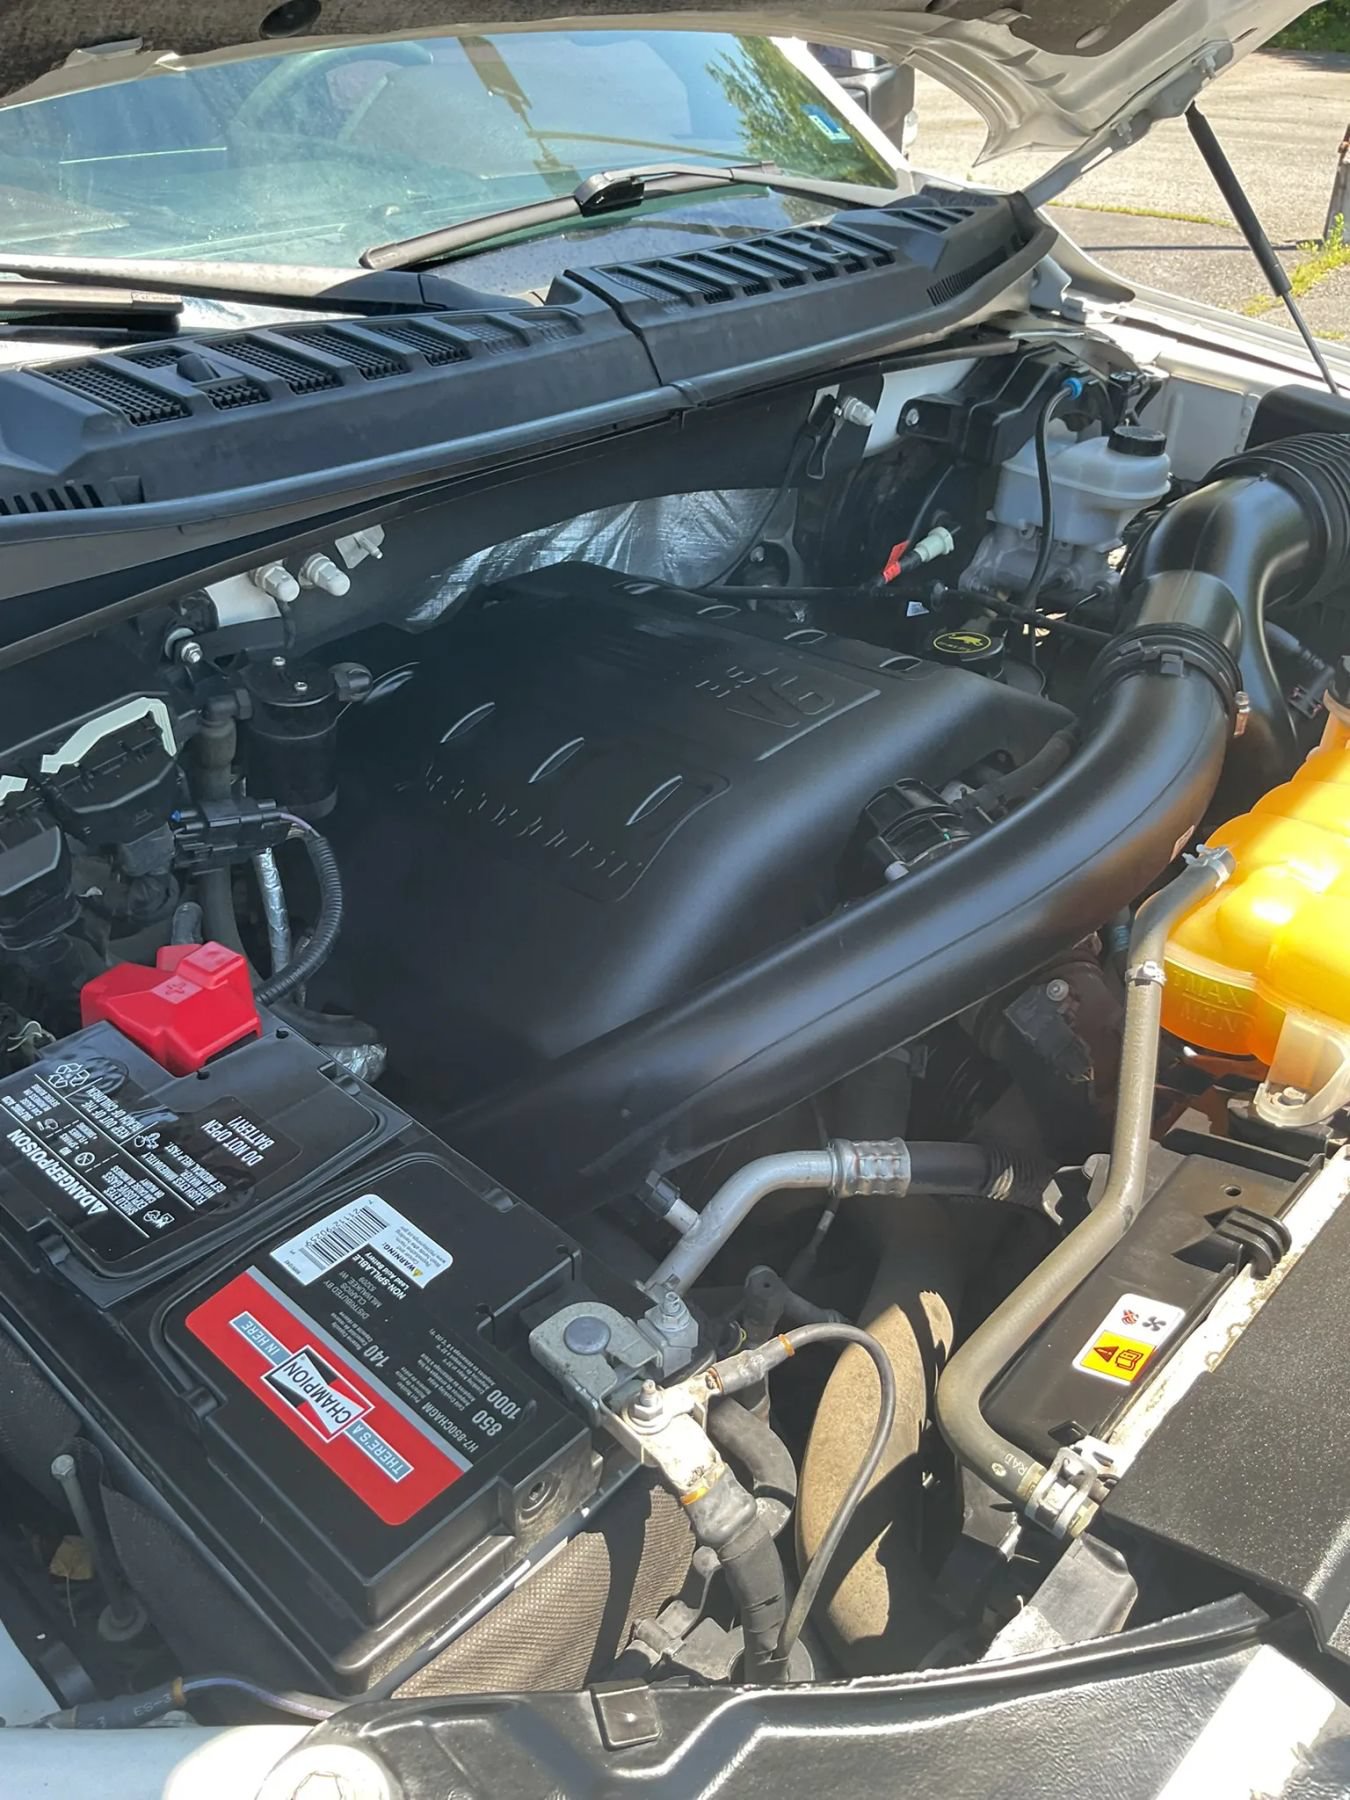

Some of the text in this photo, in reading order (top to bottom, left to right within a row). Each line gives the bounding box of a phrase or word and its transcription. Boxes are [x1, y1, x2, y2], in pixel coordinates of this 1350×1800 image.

[80, 1099, 131, 1139] KEEP OUT OF THE
[111, 1107, 126, 1118] OF
[119, 1114, 144, 1132] REACH
[200, 1118, 264, 1166] DO NOT OPEN
[226, 1115, 275, 1150] BATTERY!
[5, 1127, 98, 1207] DANGER/POISON
[176, 1153, 195, 1167] HELP
[189, 1163, 216, 1184] MEDICAL
[101, 1170, 149, 1209] EXPLOSIVE GASES
[171, 1176, 191, 1191] EYES
[183, 1187, 207, 1205] FLUSH
[210, 1180, 227, 1192] GET
[102, 1186, 139, 1215] SHIELD EYES
[363, 1251, 409, 1290] Lead Acid Battery
[380, 1241, 416, 1271] WARNING:
[351, 1253, 406, 1299] NON-SPILLABLE
[322, 1278, 370, 1319] DISTRIBUTED BY
[339, 1281, 367, 1305] CLARIOS
[362, 1343, 392, 1368] 140
[240, 1319, 405, 1474] THERE'S A CHAMPION IN HERE
[485, 1388, 523, 1421] 1000
[421, 1401, 479, 1452] H7-850CHAGM
[469, 1408, 504, 1437] 850
[1004, 1453, 1028, 1476] RAD
